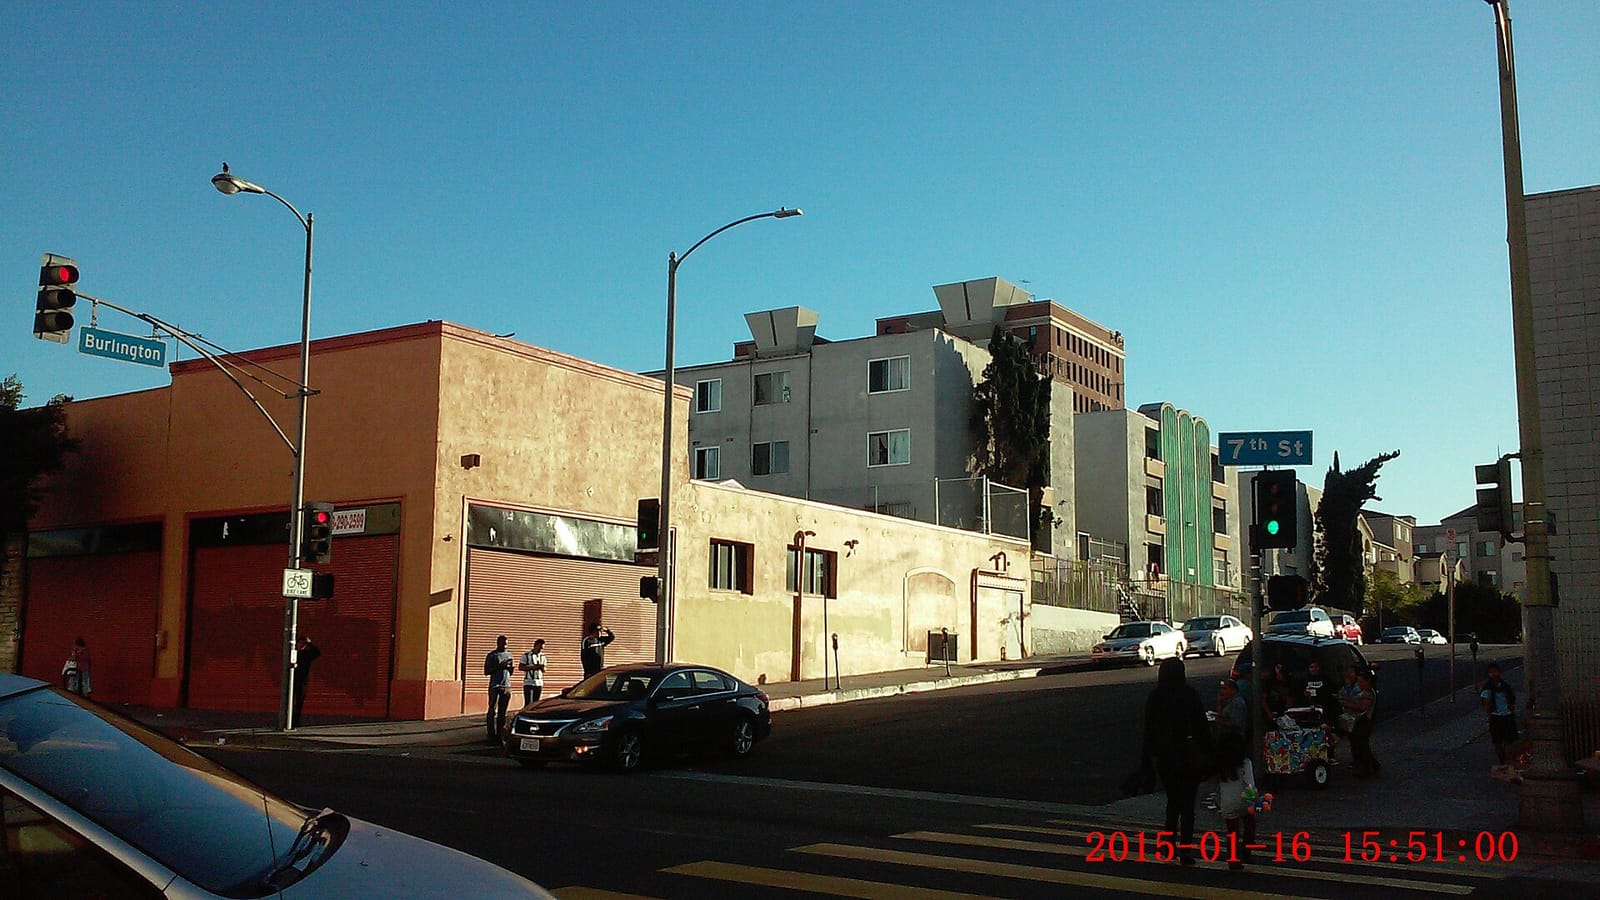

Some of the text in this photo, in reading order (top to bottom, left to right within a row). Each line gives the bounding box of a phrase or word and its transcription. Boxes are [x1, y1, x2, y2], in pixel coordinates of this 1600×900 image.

[84, 333, 161, 361] Burlington
[1226, 438, 1304, 460] 7th St
